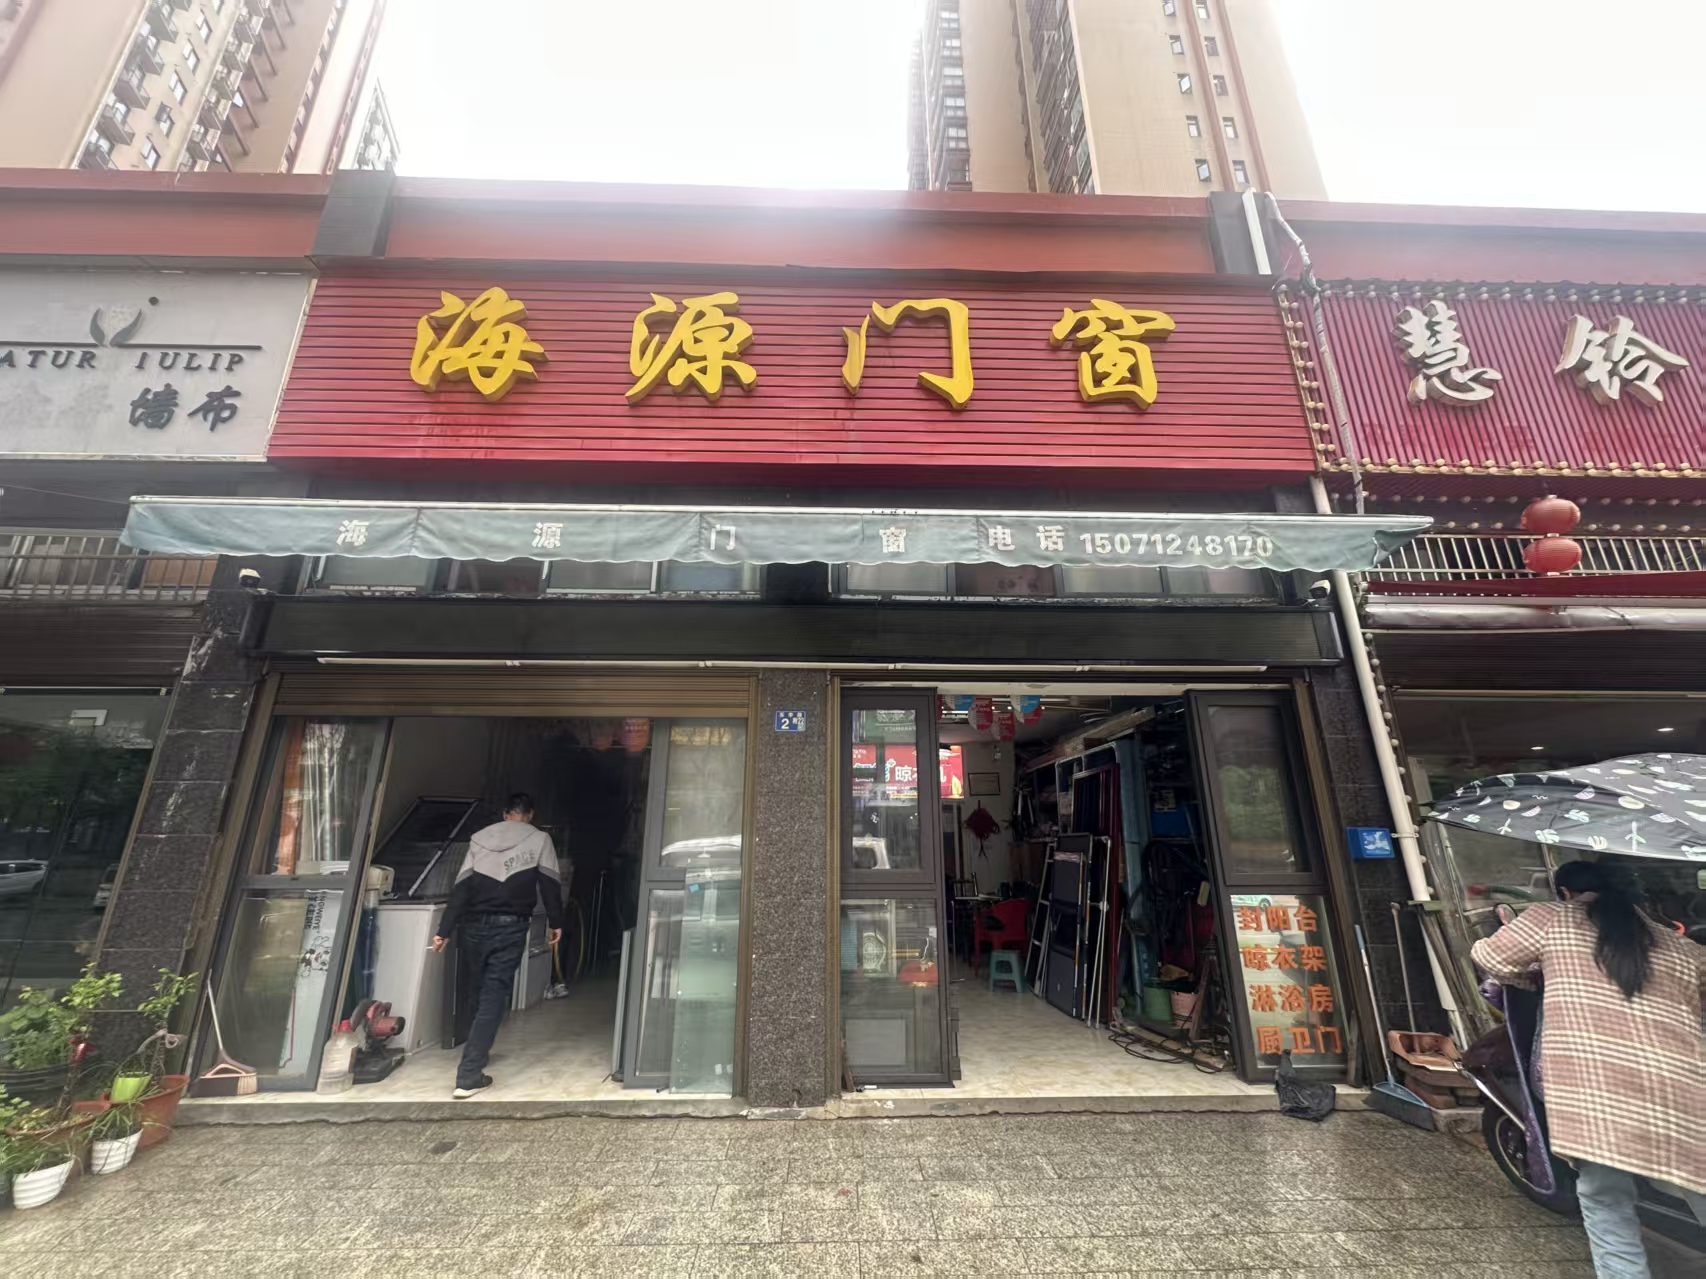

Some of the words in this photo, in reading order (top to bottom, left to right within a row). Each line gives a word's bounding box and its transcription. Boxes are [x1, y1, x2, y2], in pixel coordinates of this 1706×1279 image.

[409, 286, 1177, 411] 海源门窗
[336, 519, 906, 553] 海源门窗
[988, 525, 1065, 551] 电话
[1079, 532, 1273, 558] 15071248170
[1236, 905, 1317, 932] 封阳台
[1241, 944, 1327, 972] 晾衣架
[1249, 984, 1333, 1012] 淋浴房
[1256, 1025, 1341, 1055] 厨卫门
